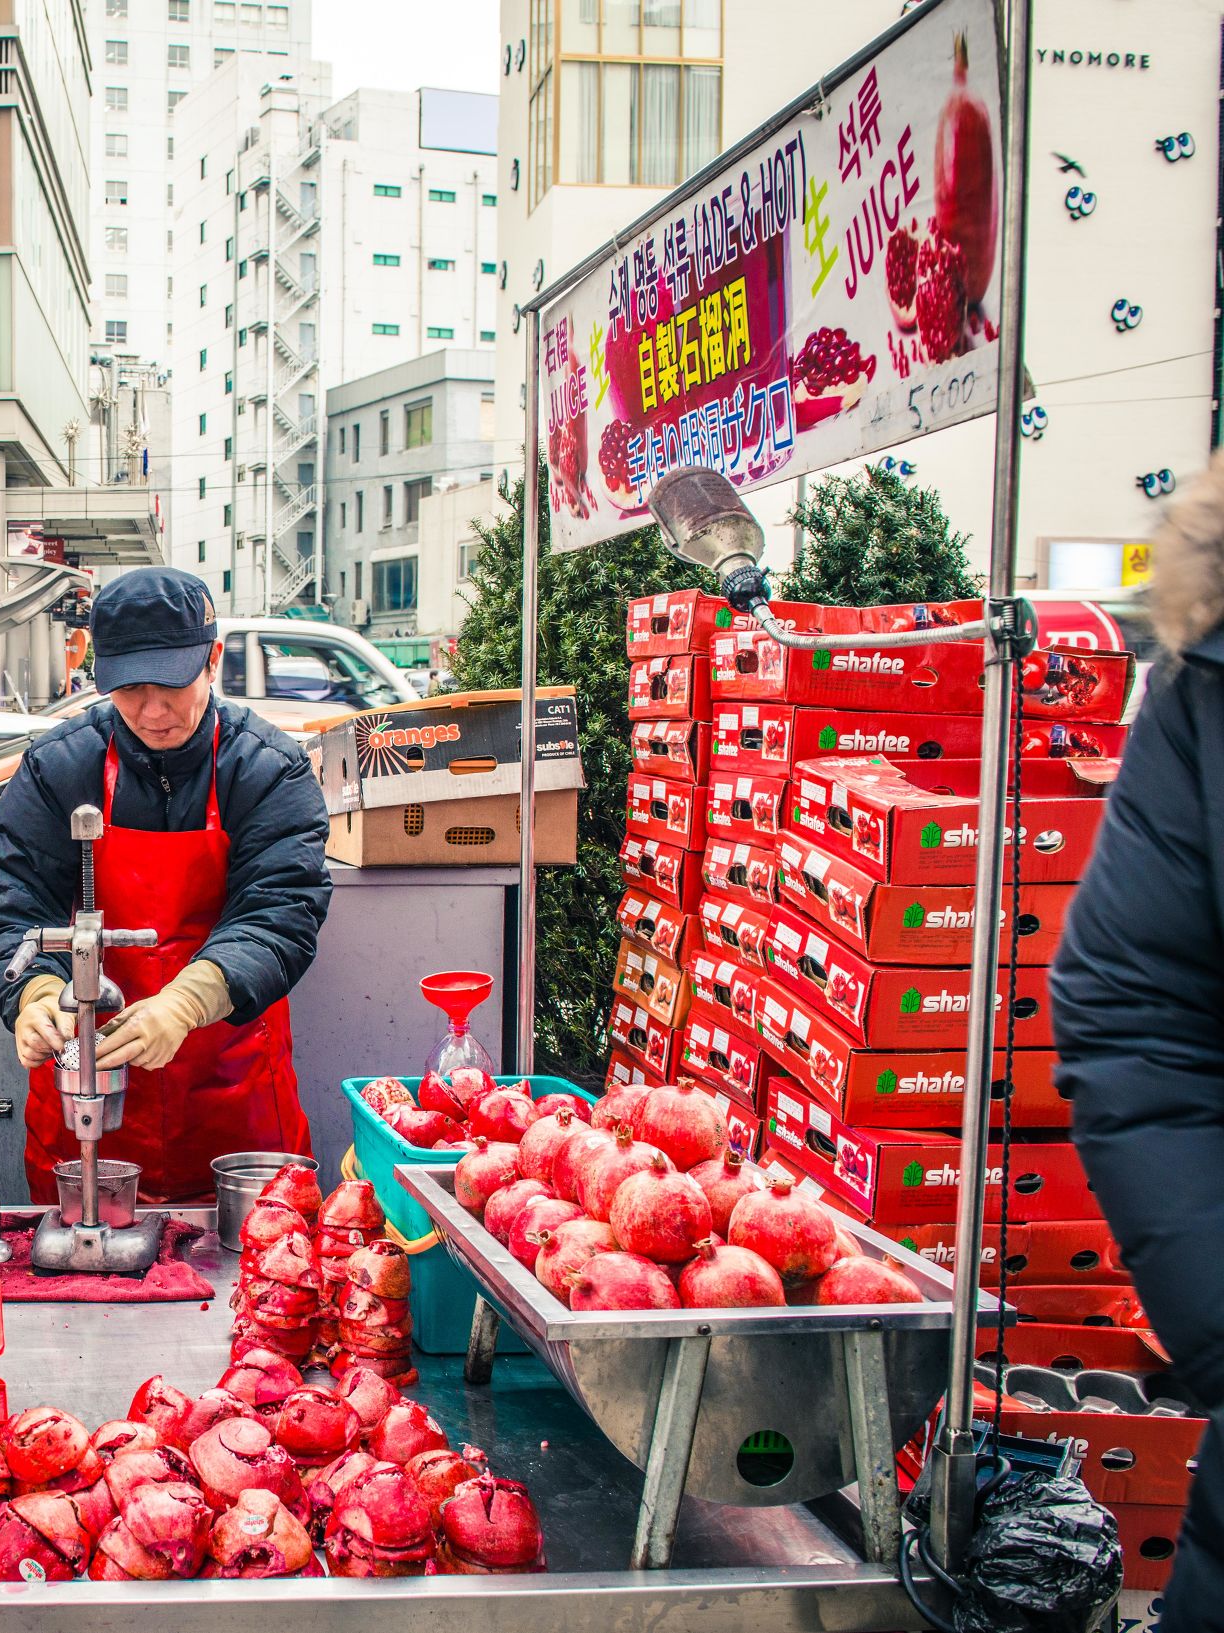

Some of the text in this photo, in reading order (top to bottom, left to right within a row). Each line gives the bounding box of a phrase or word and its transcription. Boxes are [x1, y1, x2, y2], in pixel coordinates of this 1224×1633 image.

[838, 64, 882, 184] 석류
[609, 129, 807, 341] 수제 명동 석류 (ADE & HOT)
[804, 175, 839, 299] 生
[844, 124, 920, 300] JUICE
[543, 316, 569, 377] 石榴
[590, 320, 610, 411] 生
[638, 276, 751, 414] 自製石榴洞
[548, 365, 588, 436] JUICE
[628, 376, 796, 505] 手作り明洞ザクロ
[733, 613, 796, 631] shee
[832, 650, 905, 675] shafee
[368, 724, 461, 749] oranges
[547, 704, 571, 715] CAT1
[536, 740, 575, 752] subsole
[838, 729, 911, 752] shafee
[943, 823, 1027, 848] shee
[898, 1071, 966, 1094] shafe
